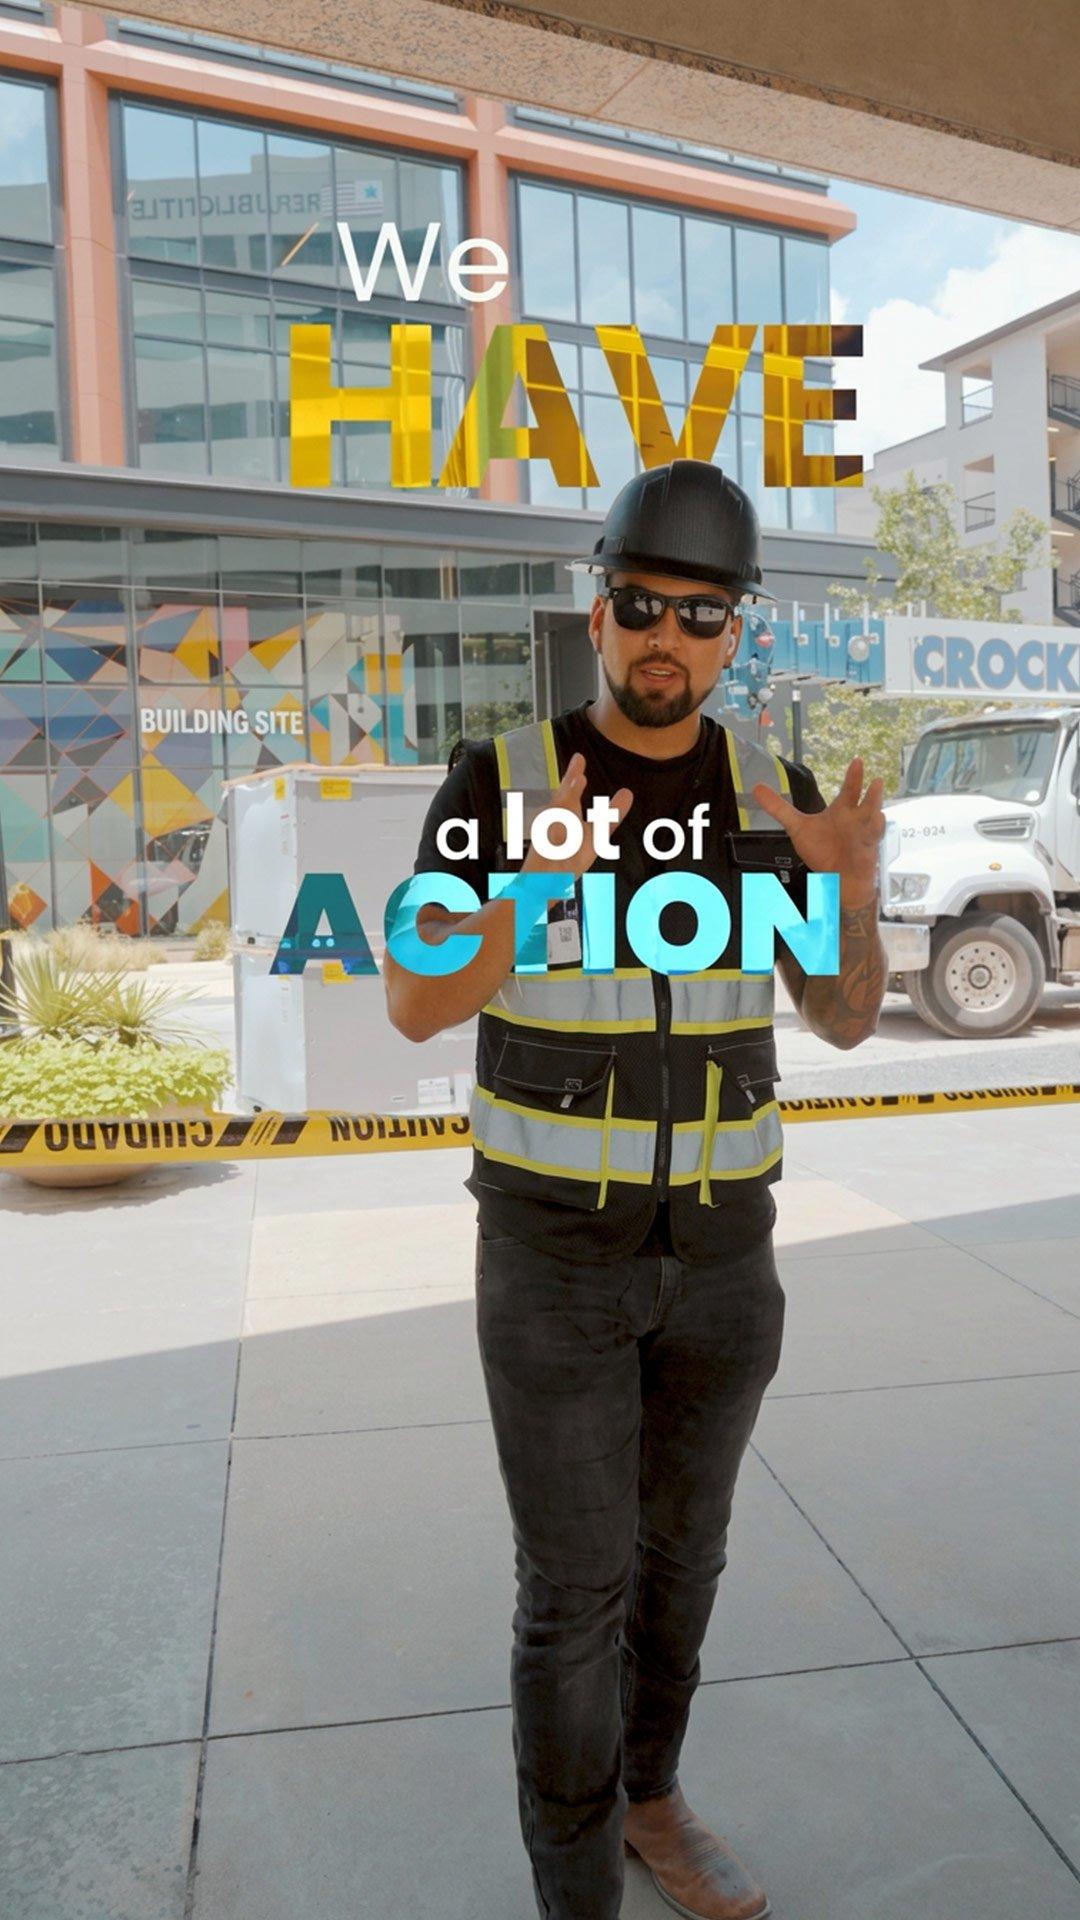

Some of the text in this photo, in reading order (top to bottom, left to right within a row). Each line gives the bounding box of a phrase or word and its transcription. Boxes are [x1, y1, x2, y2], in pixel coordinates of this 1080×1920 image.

[140, 708, 303, 735] BUILDING SITE
[44, 1120, 213, 1152] CUIDADO
[328, 1115, 471, 1142] CAUTION
